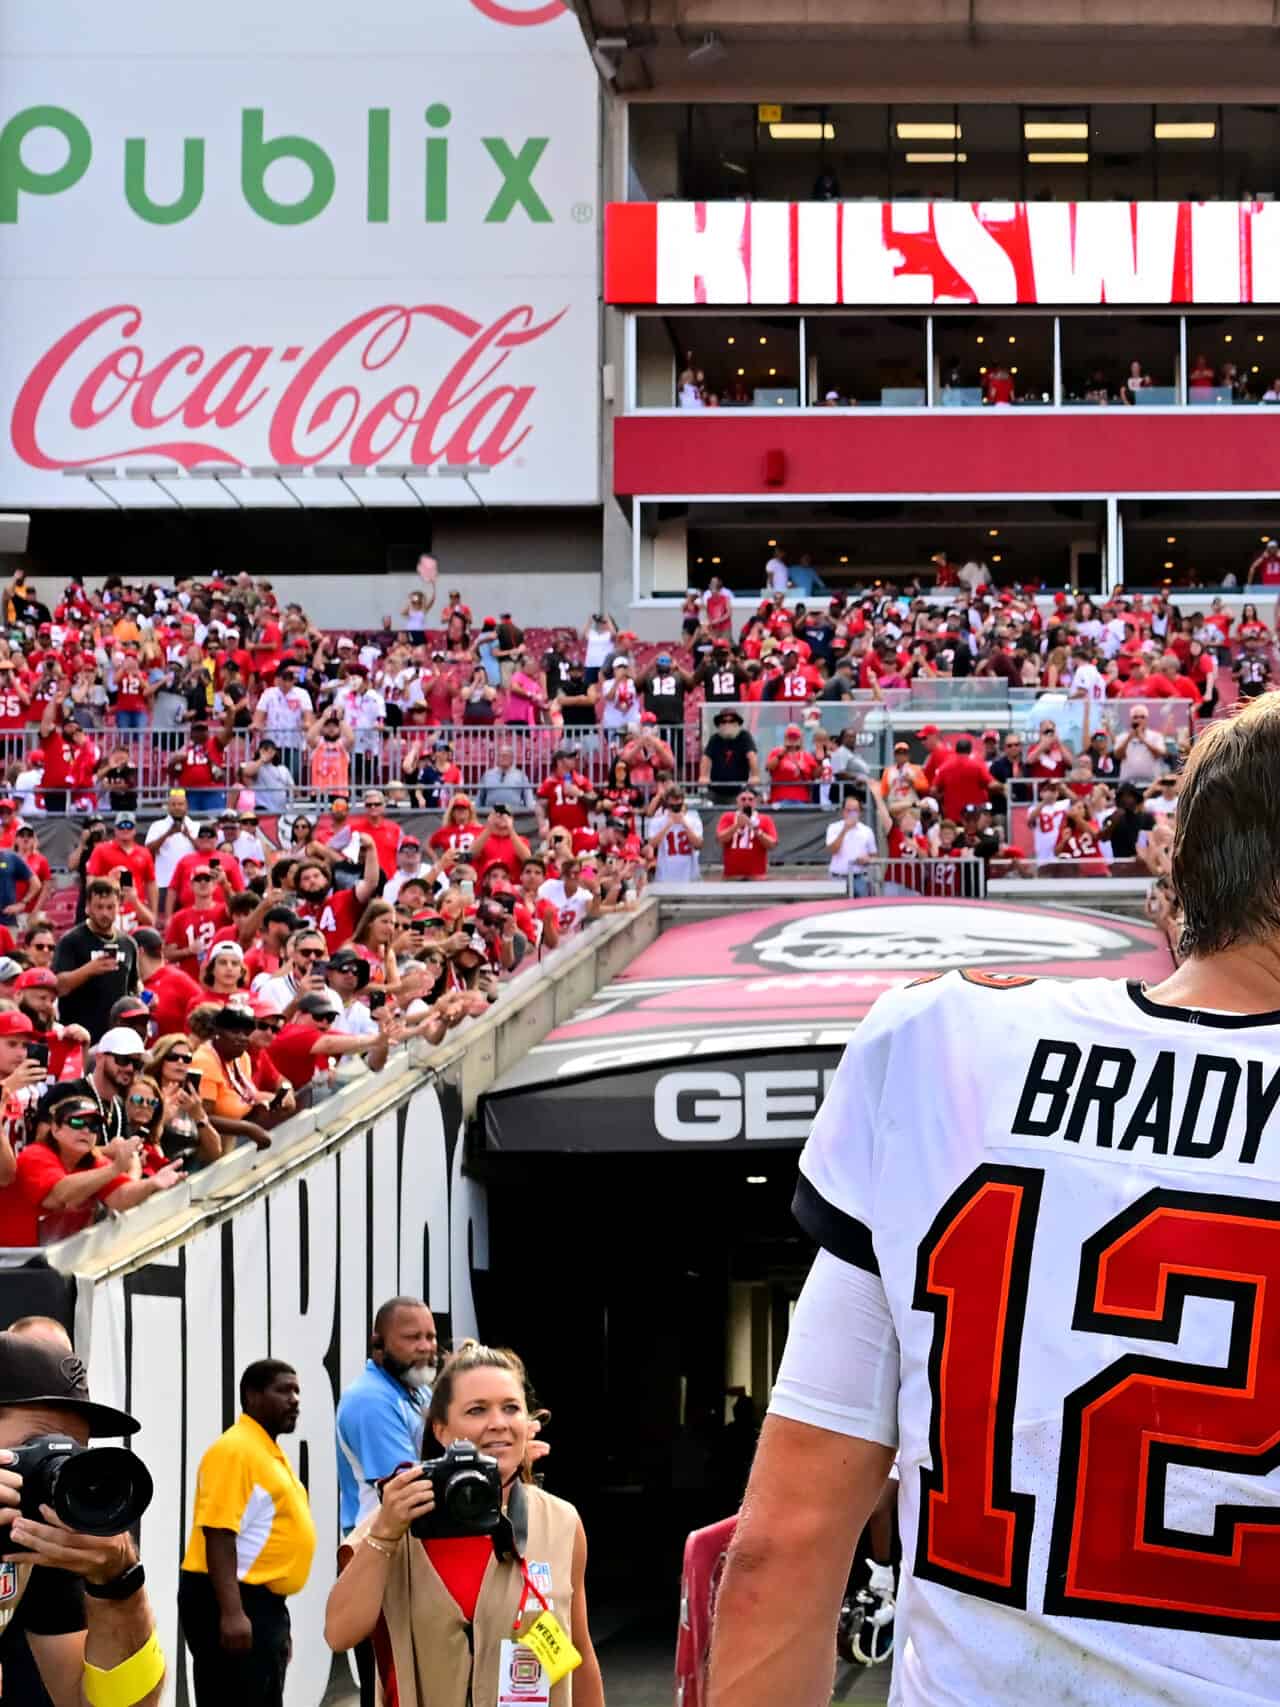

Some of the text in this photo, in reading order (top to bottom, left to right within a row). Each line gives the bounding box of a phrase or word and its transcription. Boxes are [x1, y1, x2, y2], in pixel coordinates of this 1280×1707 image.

[0, 103, 554, 225] Publix
[10, 303, 571, 471] Coca-Cola
[121, 676, 140, 694] 12
[652, 674, 676, 696] 12
[712, 672, 735, 695] 12
[784, 675, 807, 698] 13
[666, 831, 692, 856] 12
[1068, 832, 1097, 859] 12
[184, 921, 216, 947] 12
